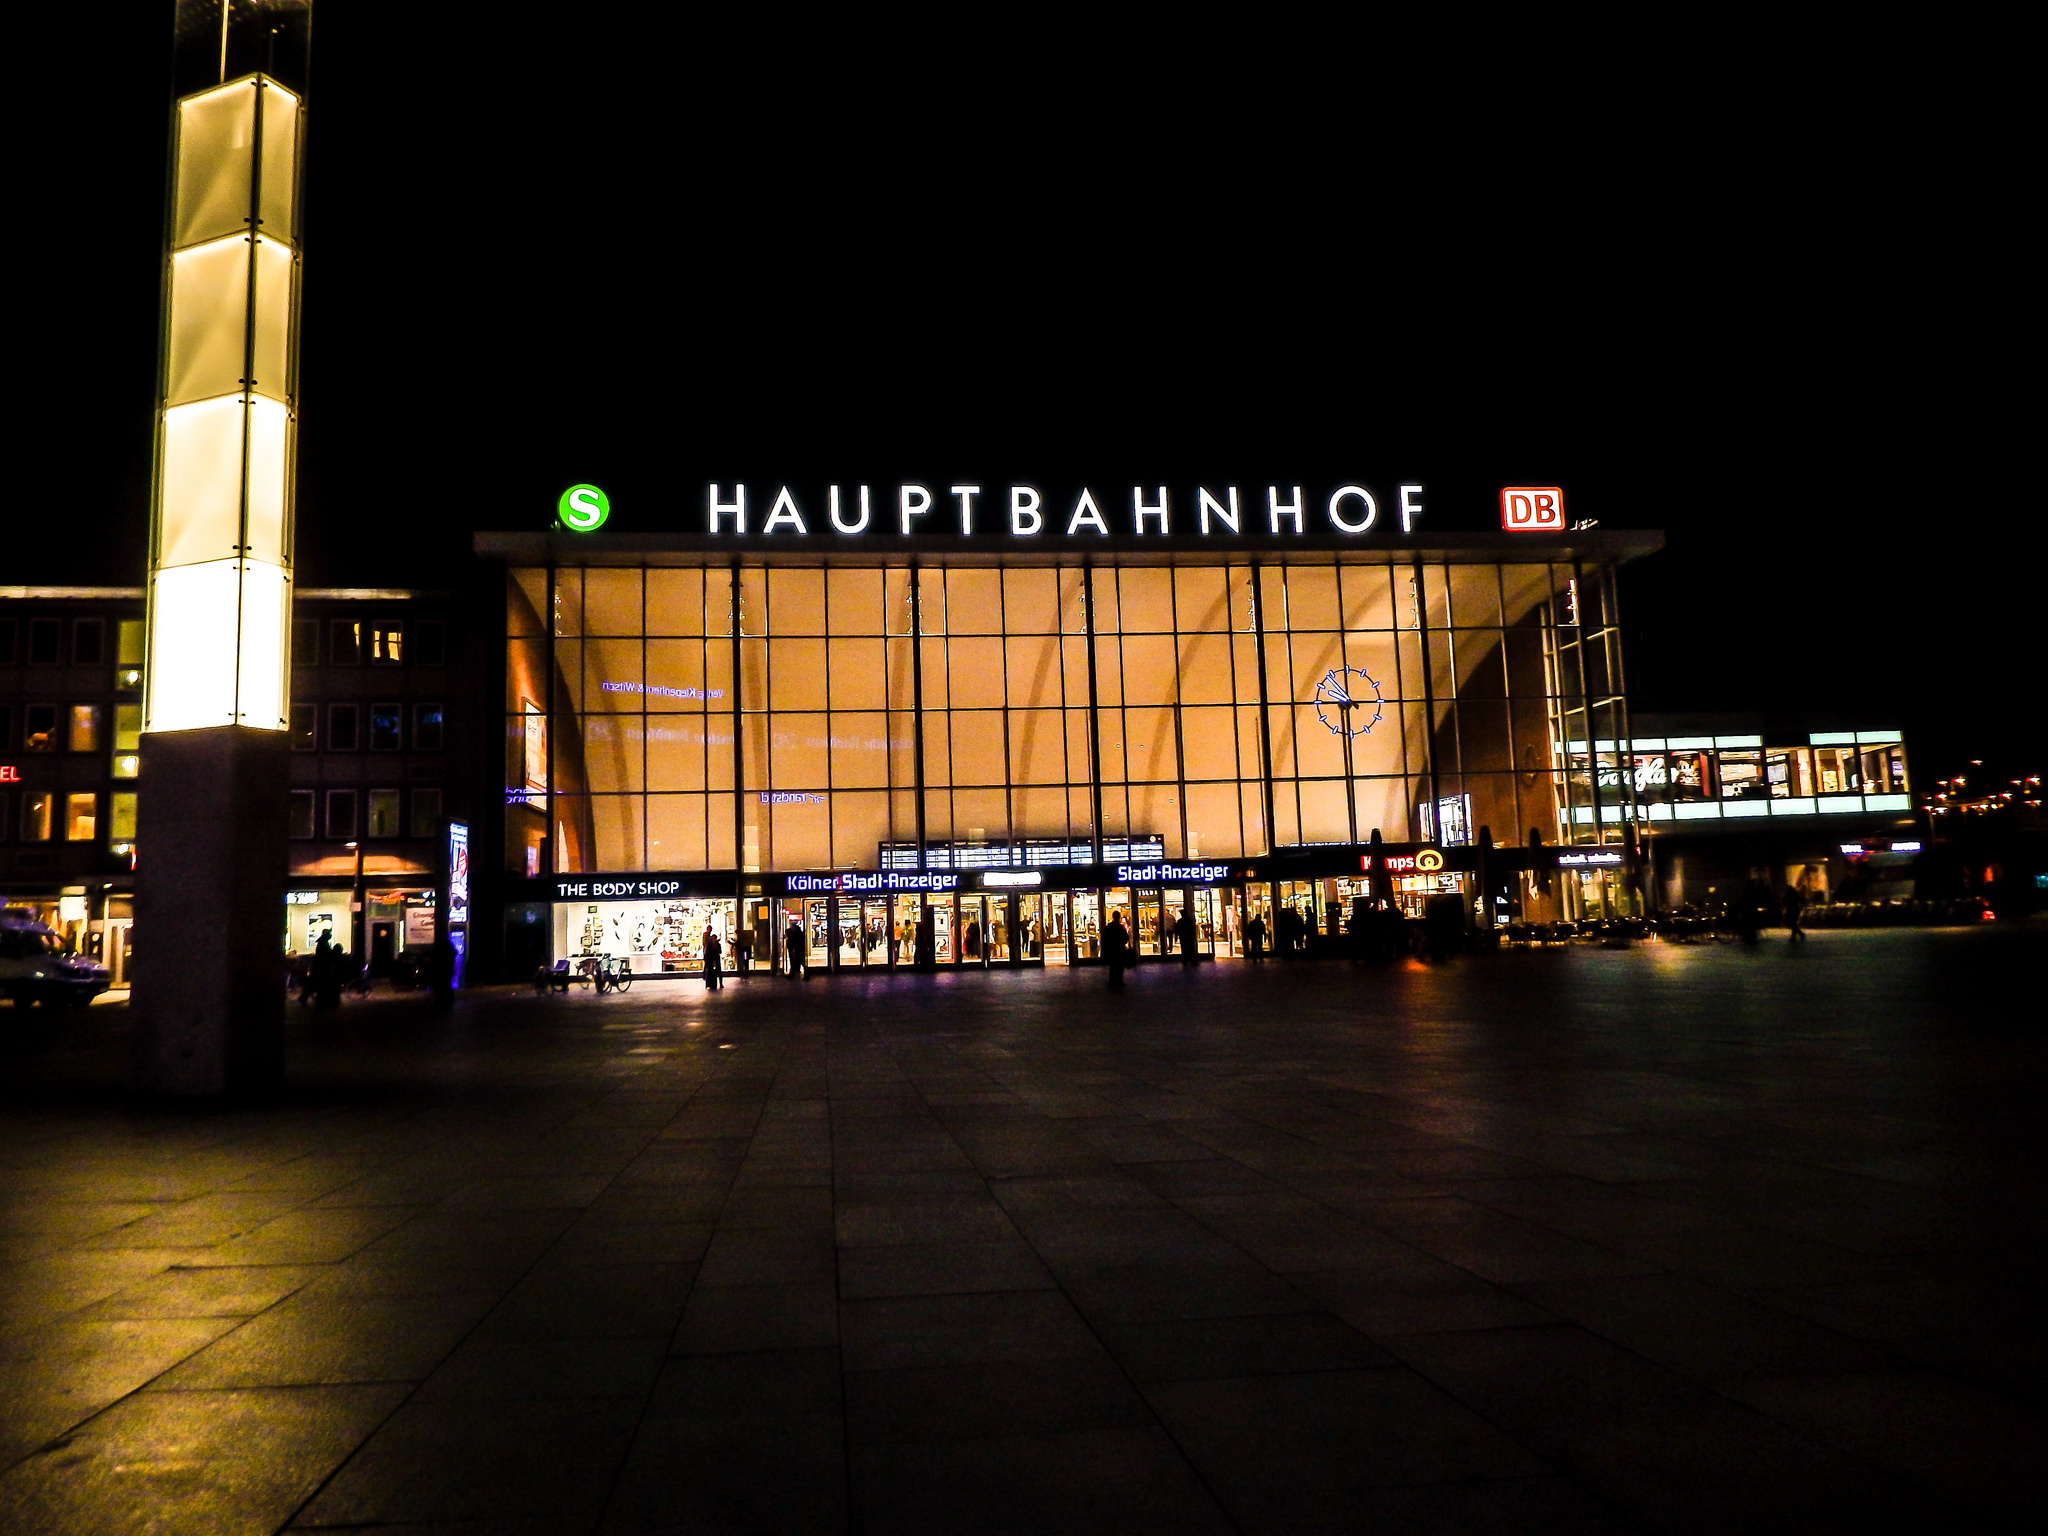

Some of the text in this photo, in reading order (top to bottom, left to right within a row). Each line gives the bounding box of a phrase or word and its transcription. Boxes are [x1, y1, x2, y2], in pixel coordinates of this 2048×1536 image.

[568, 488, 601, 527] S
[710, 484, 1422, 534] HAUPTBAHNHOF
[1510, 494, 1556, 523] DB
[787, 872, 958, 890] Kölner Stadt-Anzeiger
[1118, 863, 1229, 881] Stadt-Anzeiger
[557, 881, 679, 896] THE BODY SHOP
